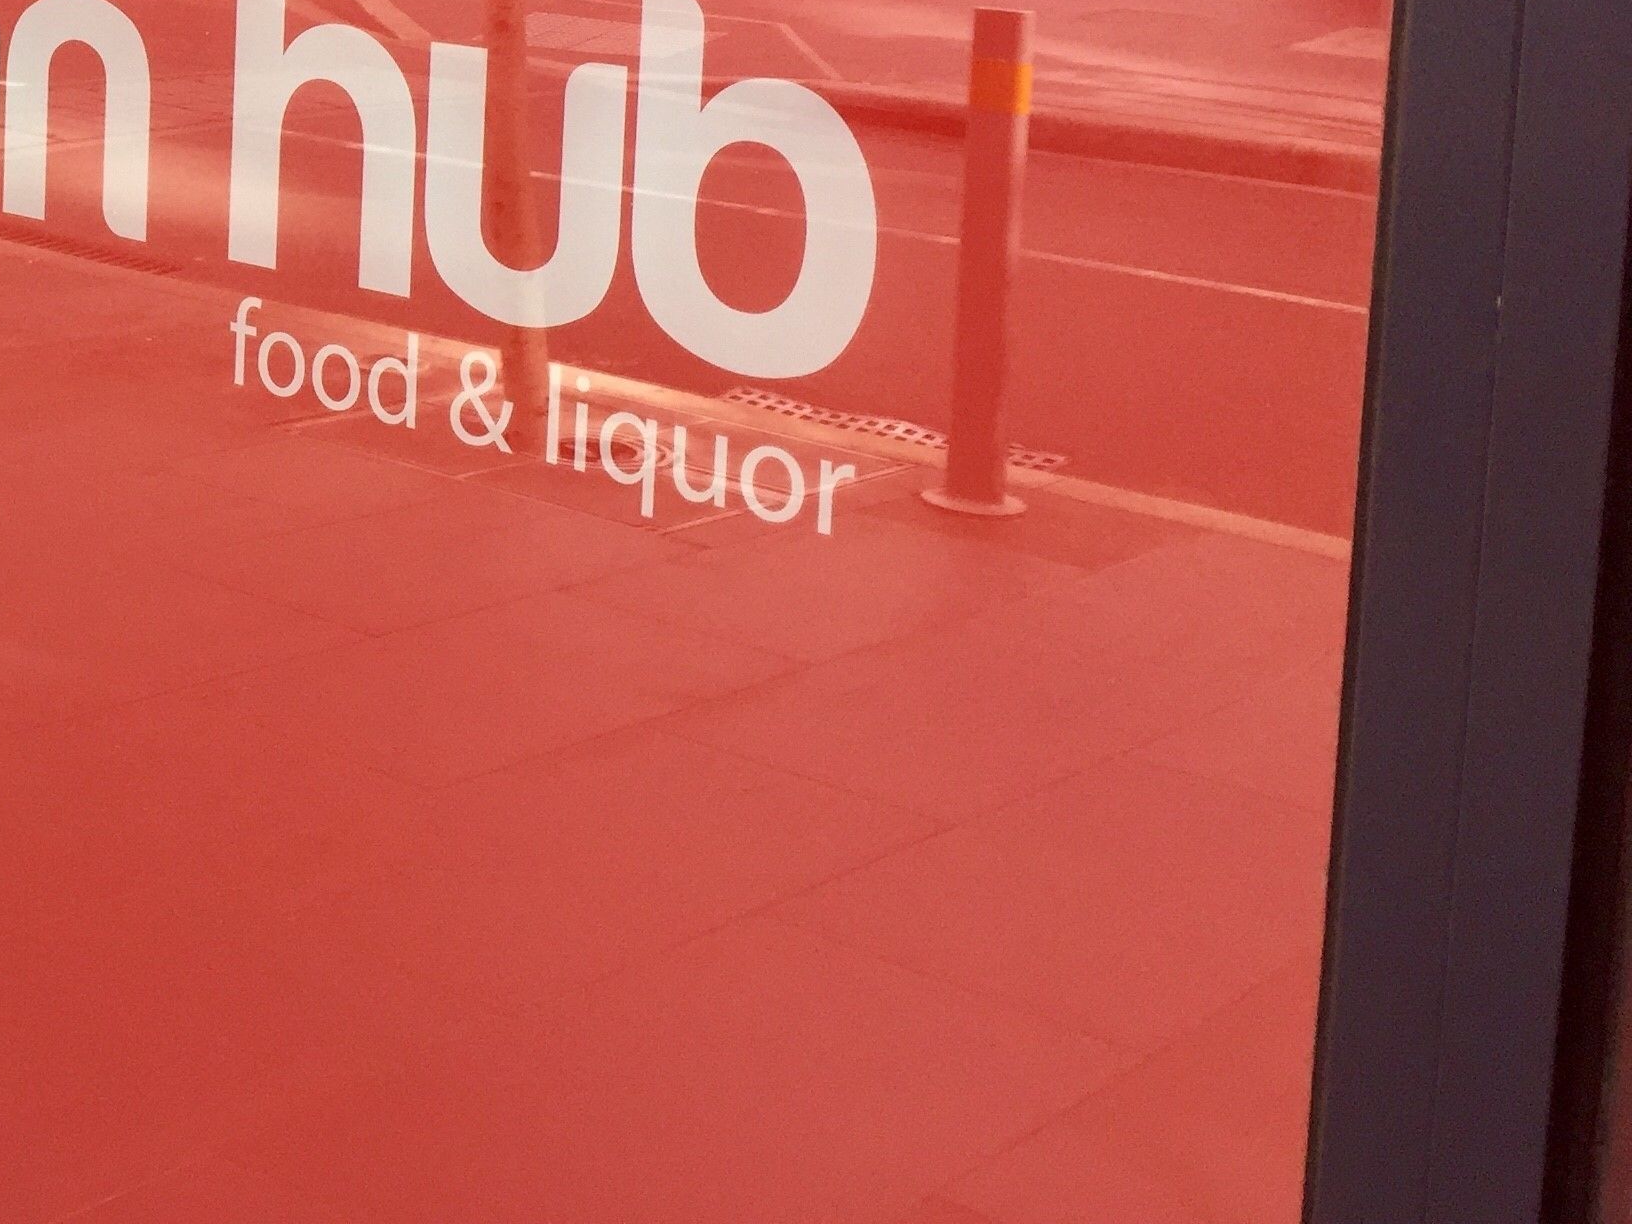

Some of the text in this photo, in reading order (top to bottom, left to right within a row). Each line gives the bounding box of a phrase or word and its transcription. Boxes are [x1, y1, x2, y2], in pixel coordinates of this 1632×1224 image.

[230, 297, 856, 536] food & liquor
